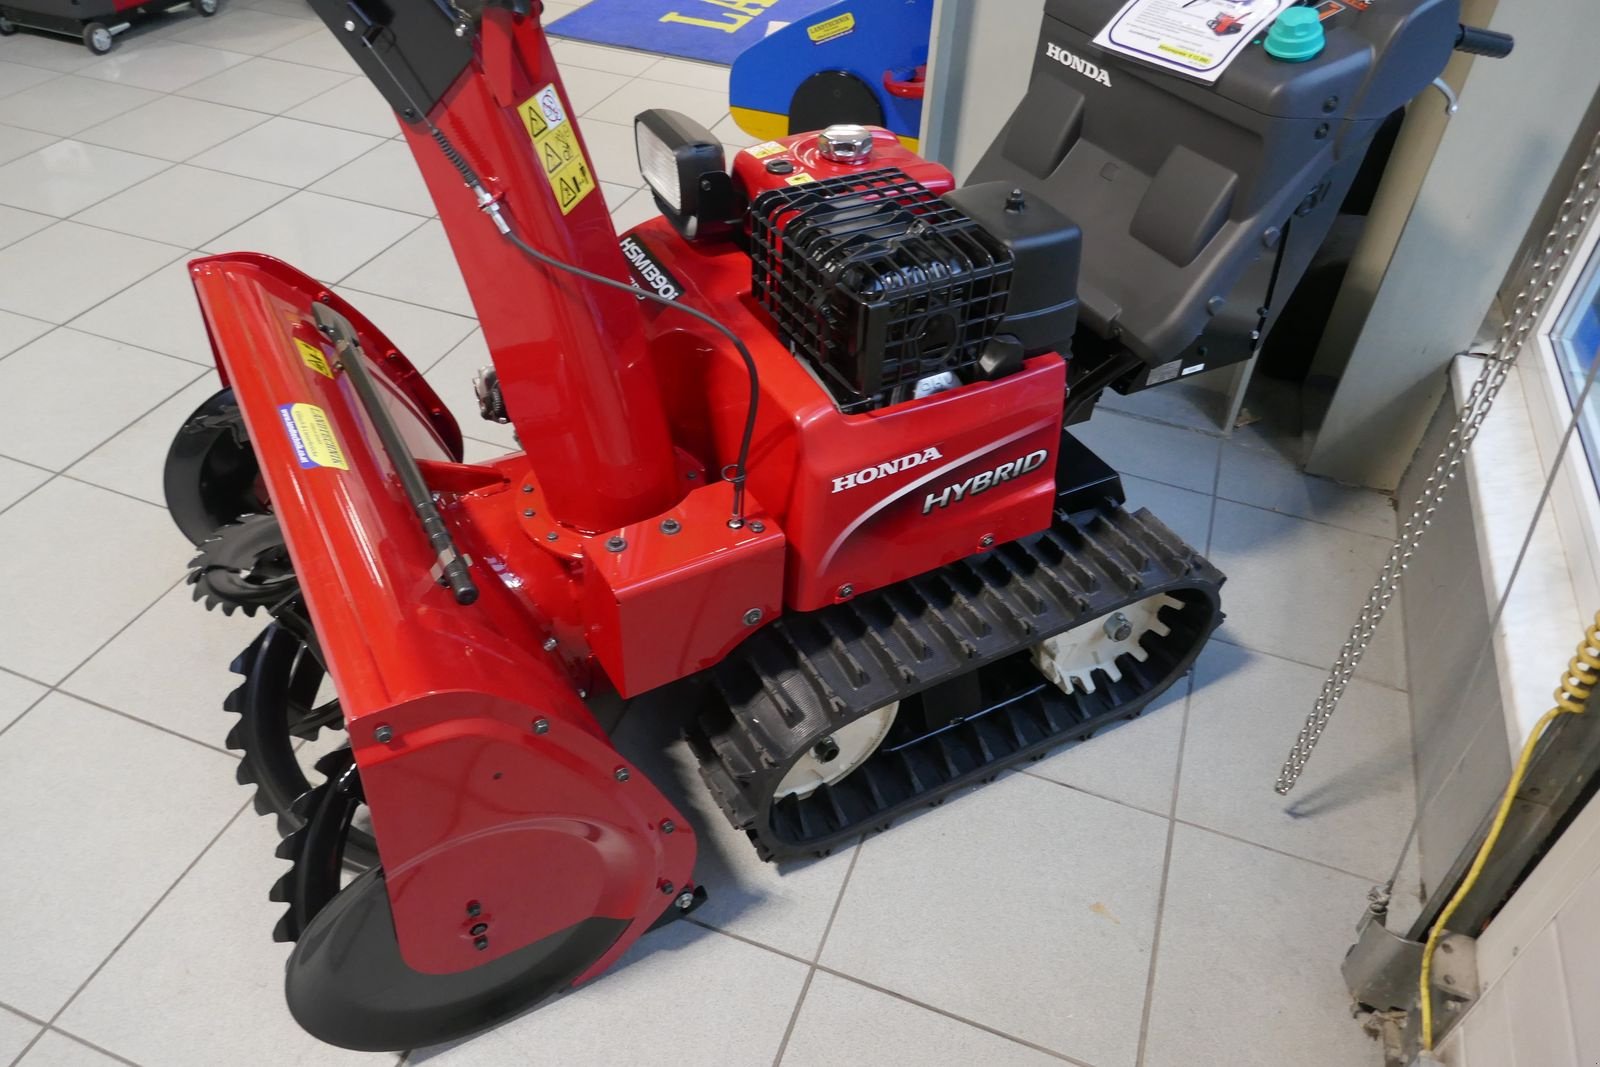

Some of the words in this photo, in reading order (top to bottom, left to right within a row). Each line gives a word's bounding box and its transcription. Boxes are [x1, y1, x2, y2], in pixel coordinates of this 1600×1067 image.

[1046, 42, 1112, 87] HONDA
[619, 237, 679, 301] HSM1390i
[832, 447, 943, 493] HONDA
[922, 450, 1048, 514] HYBRID
